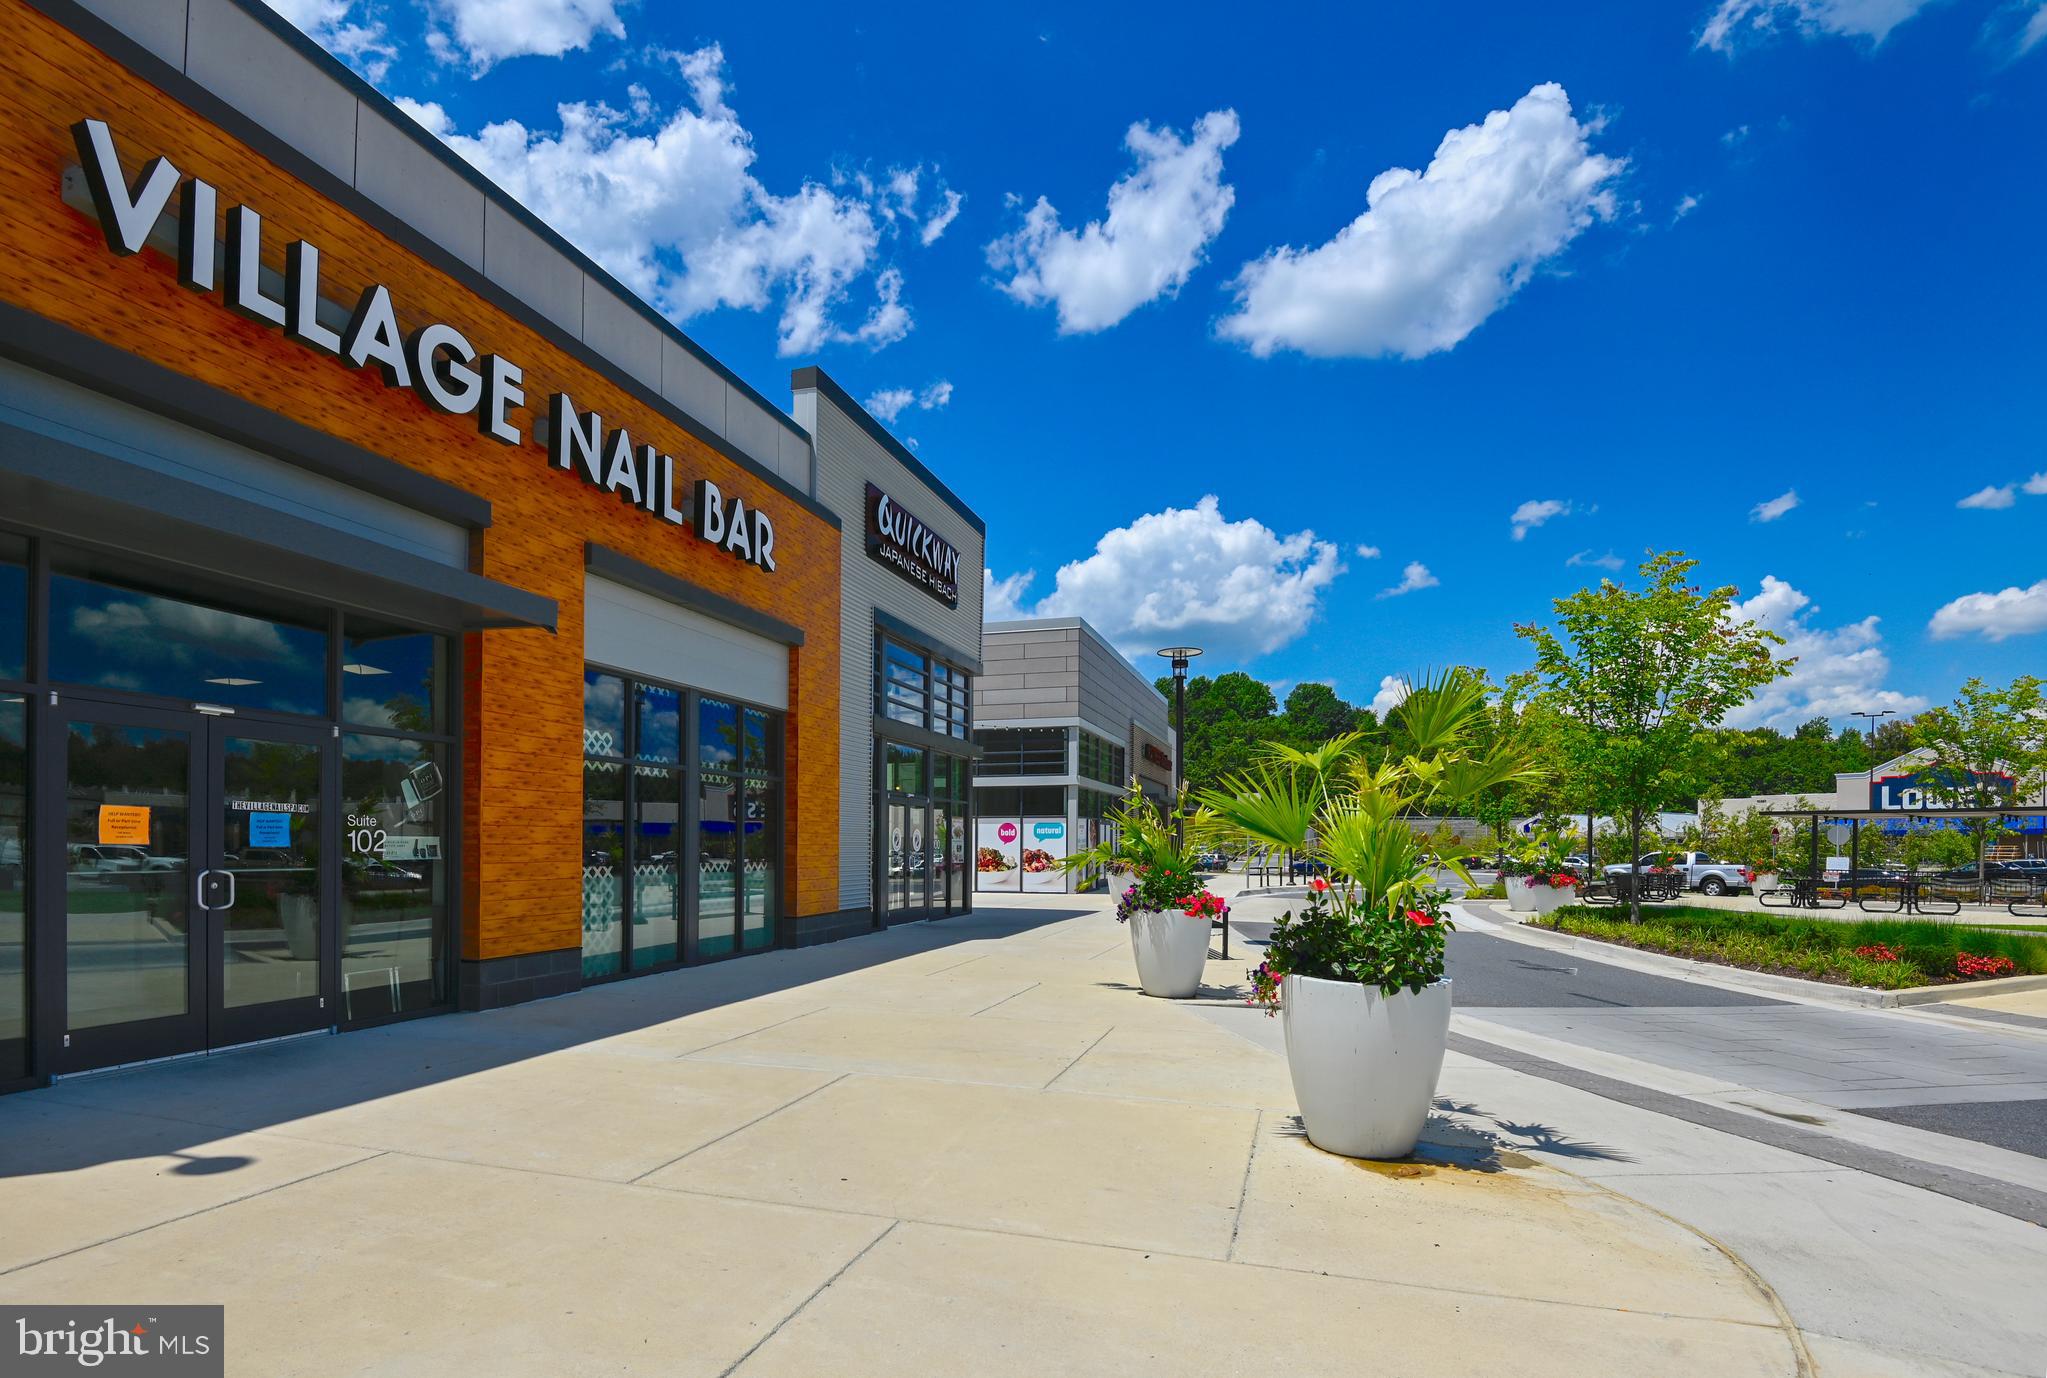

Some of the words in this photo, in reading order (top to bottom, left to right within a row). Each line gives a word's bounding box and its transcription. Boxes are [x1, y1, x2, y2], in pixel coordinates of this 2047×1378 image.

[76, 117, 526, 447] VILLAGE
[550, 391, 683, 526] NAIL
[696, 479, 777, 573] BAR
[878, 494, 960, 584] QUICKWAY
[880, 543, 927, 583] JAPANESE
[347, 814, 377, 827] Suite
[1000, 828, 1015, 836] bold
[1036, 826, 1062, 834] natural
[347, 829, 387, 852] 102
